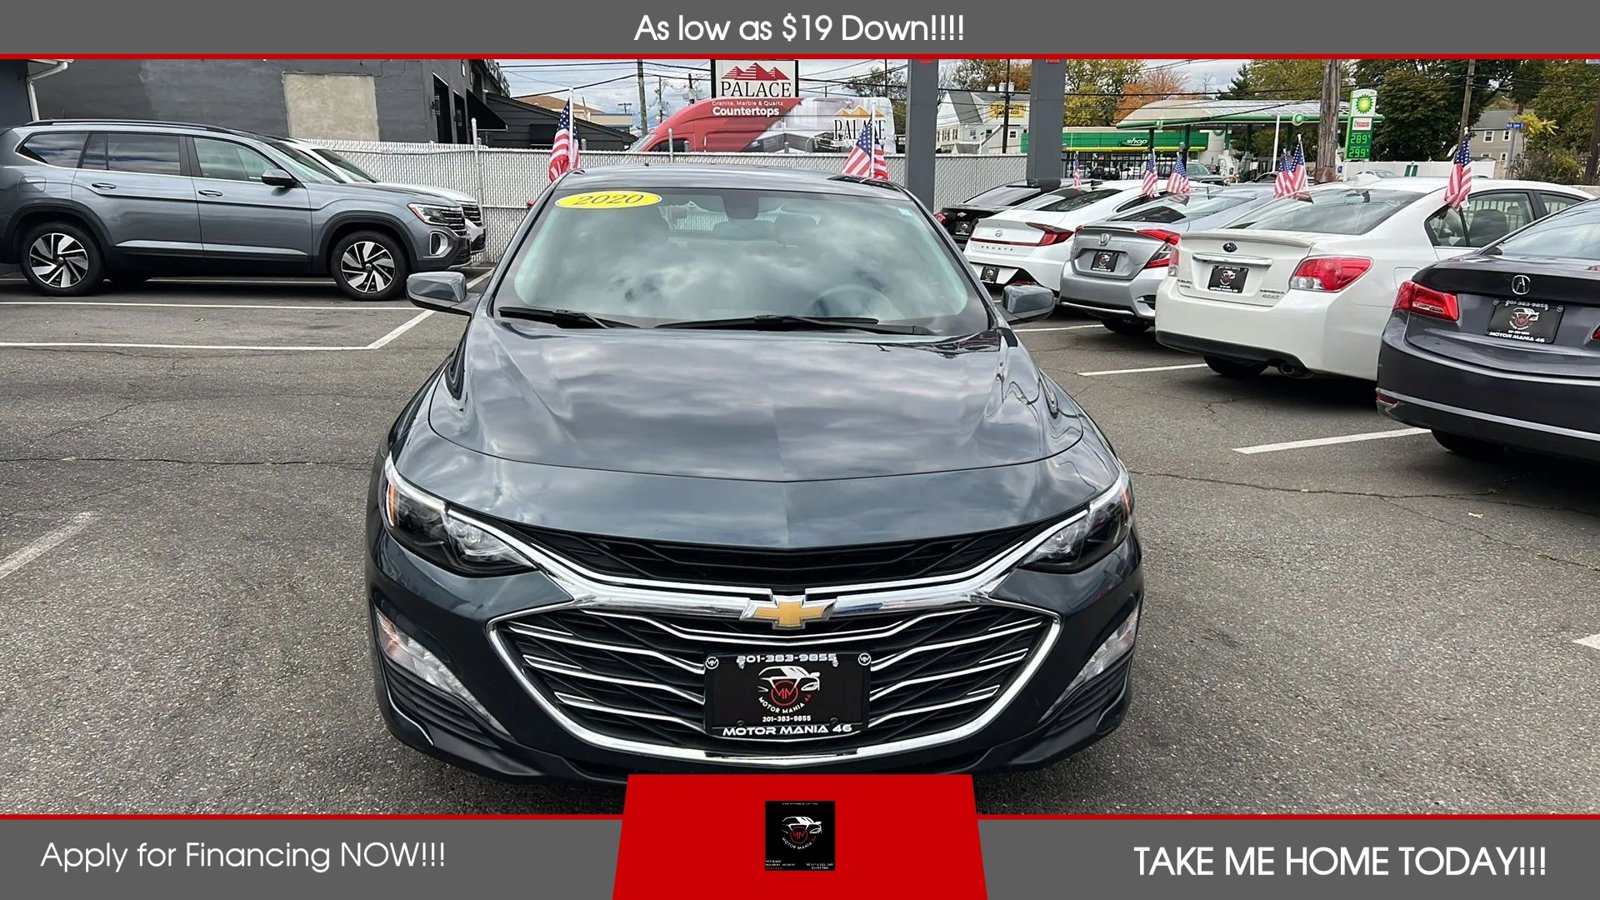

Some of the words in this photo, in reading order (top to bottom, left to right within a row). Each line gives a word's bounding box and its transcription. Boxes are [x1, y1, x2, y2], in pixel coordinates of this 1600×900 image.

[720, 81, 792, 98] PALACE
[712, 106, 780, 118] Countertops
[834, 119, 887, 140] PALE
[1350, 134, 1368, 144] 289
[1348, 148, 1366, 158] 299
[572, 194, 644, 206] 2020
[1488, 331, 1512, 339] MOTOR
[1512, 334, 1535, 342] MANIA
[758, 696, 781, 714] MOTOR
[782, 702, 805, 714] MANIA
[762, 715, 812, 723] 201-383-9855
[722, 726, 777, 736] MOTOR
[779, 725, 829, 735] MANIA
[832, 723, 853, 733] 46
